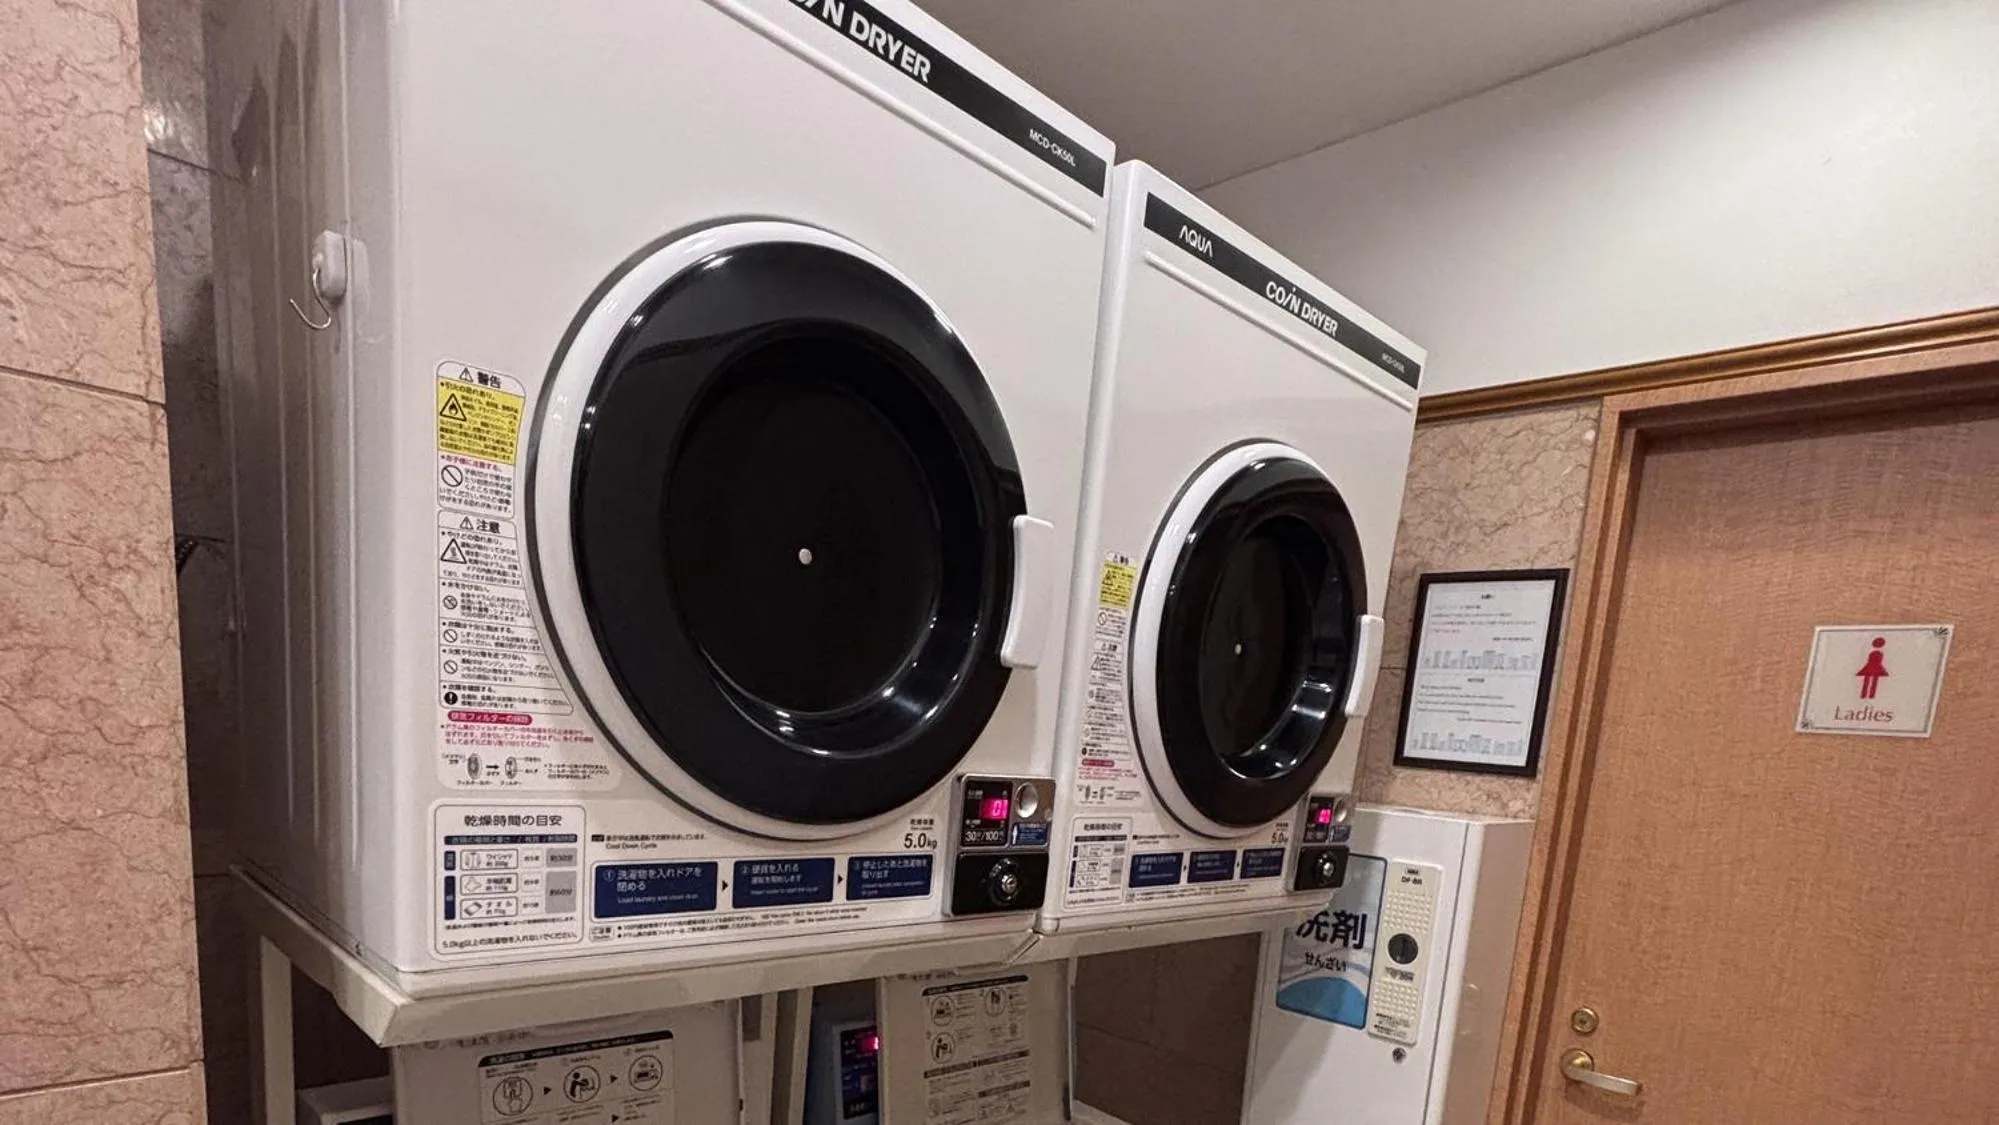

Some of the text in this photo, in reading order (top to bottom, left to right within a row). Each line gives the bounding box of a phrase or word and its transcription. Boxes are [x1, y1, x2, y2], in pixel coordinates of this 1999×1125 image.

[850, 17, 931, 83] DRYER
[1029, 128, 1076, 167] MCD-CK50L
[1179, 224, 1213, 258] AQUA
[1302, 302, 1338, 337] DRYER
[478, 372, 501, 388] 警告
[476, 518, 500, 534] 注意
[1834, 705, 1894, 722] Ladies
[464, 815, 562, 827] 乾燥時間の目安
[904, 833, 938, 850] 5.0kg
[617, 881, 646, 892] 閉める
[1305, 952, 1347, 972] せんざい
